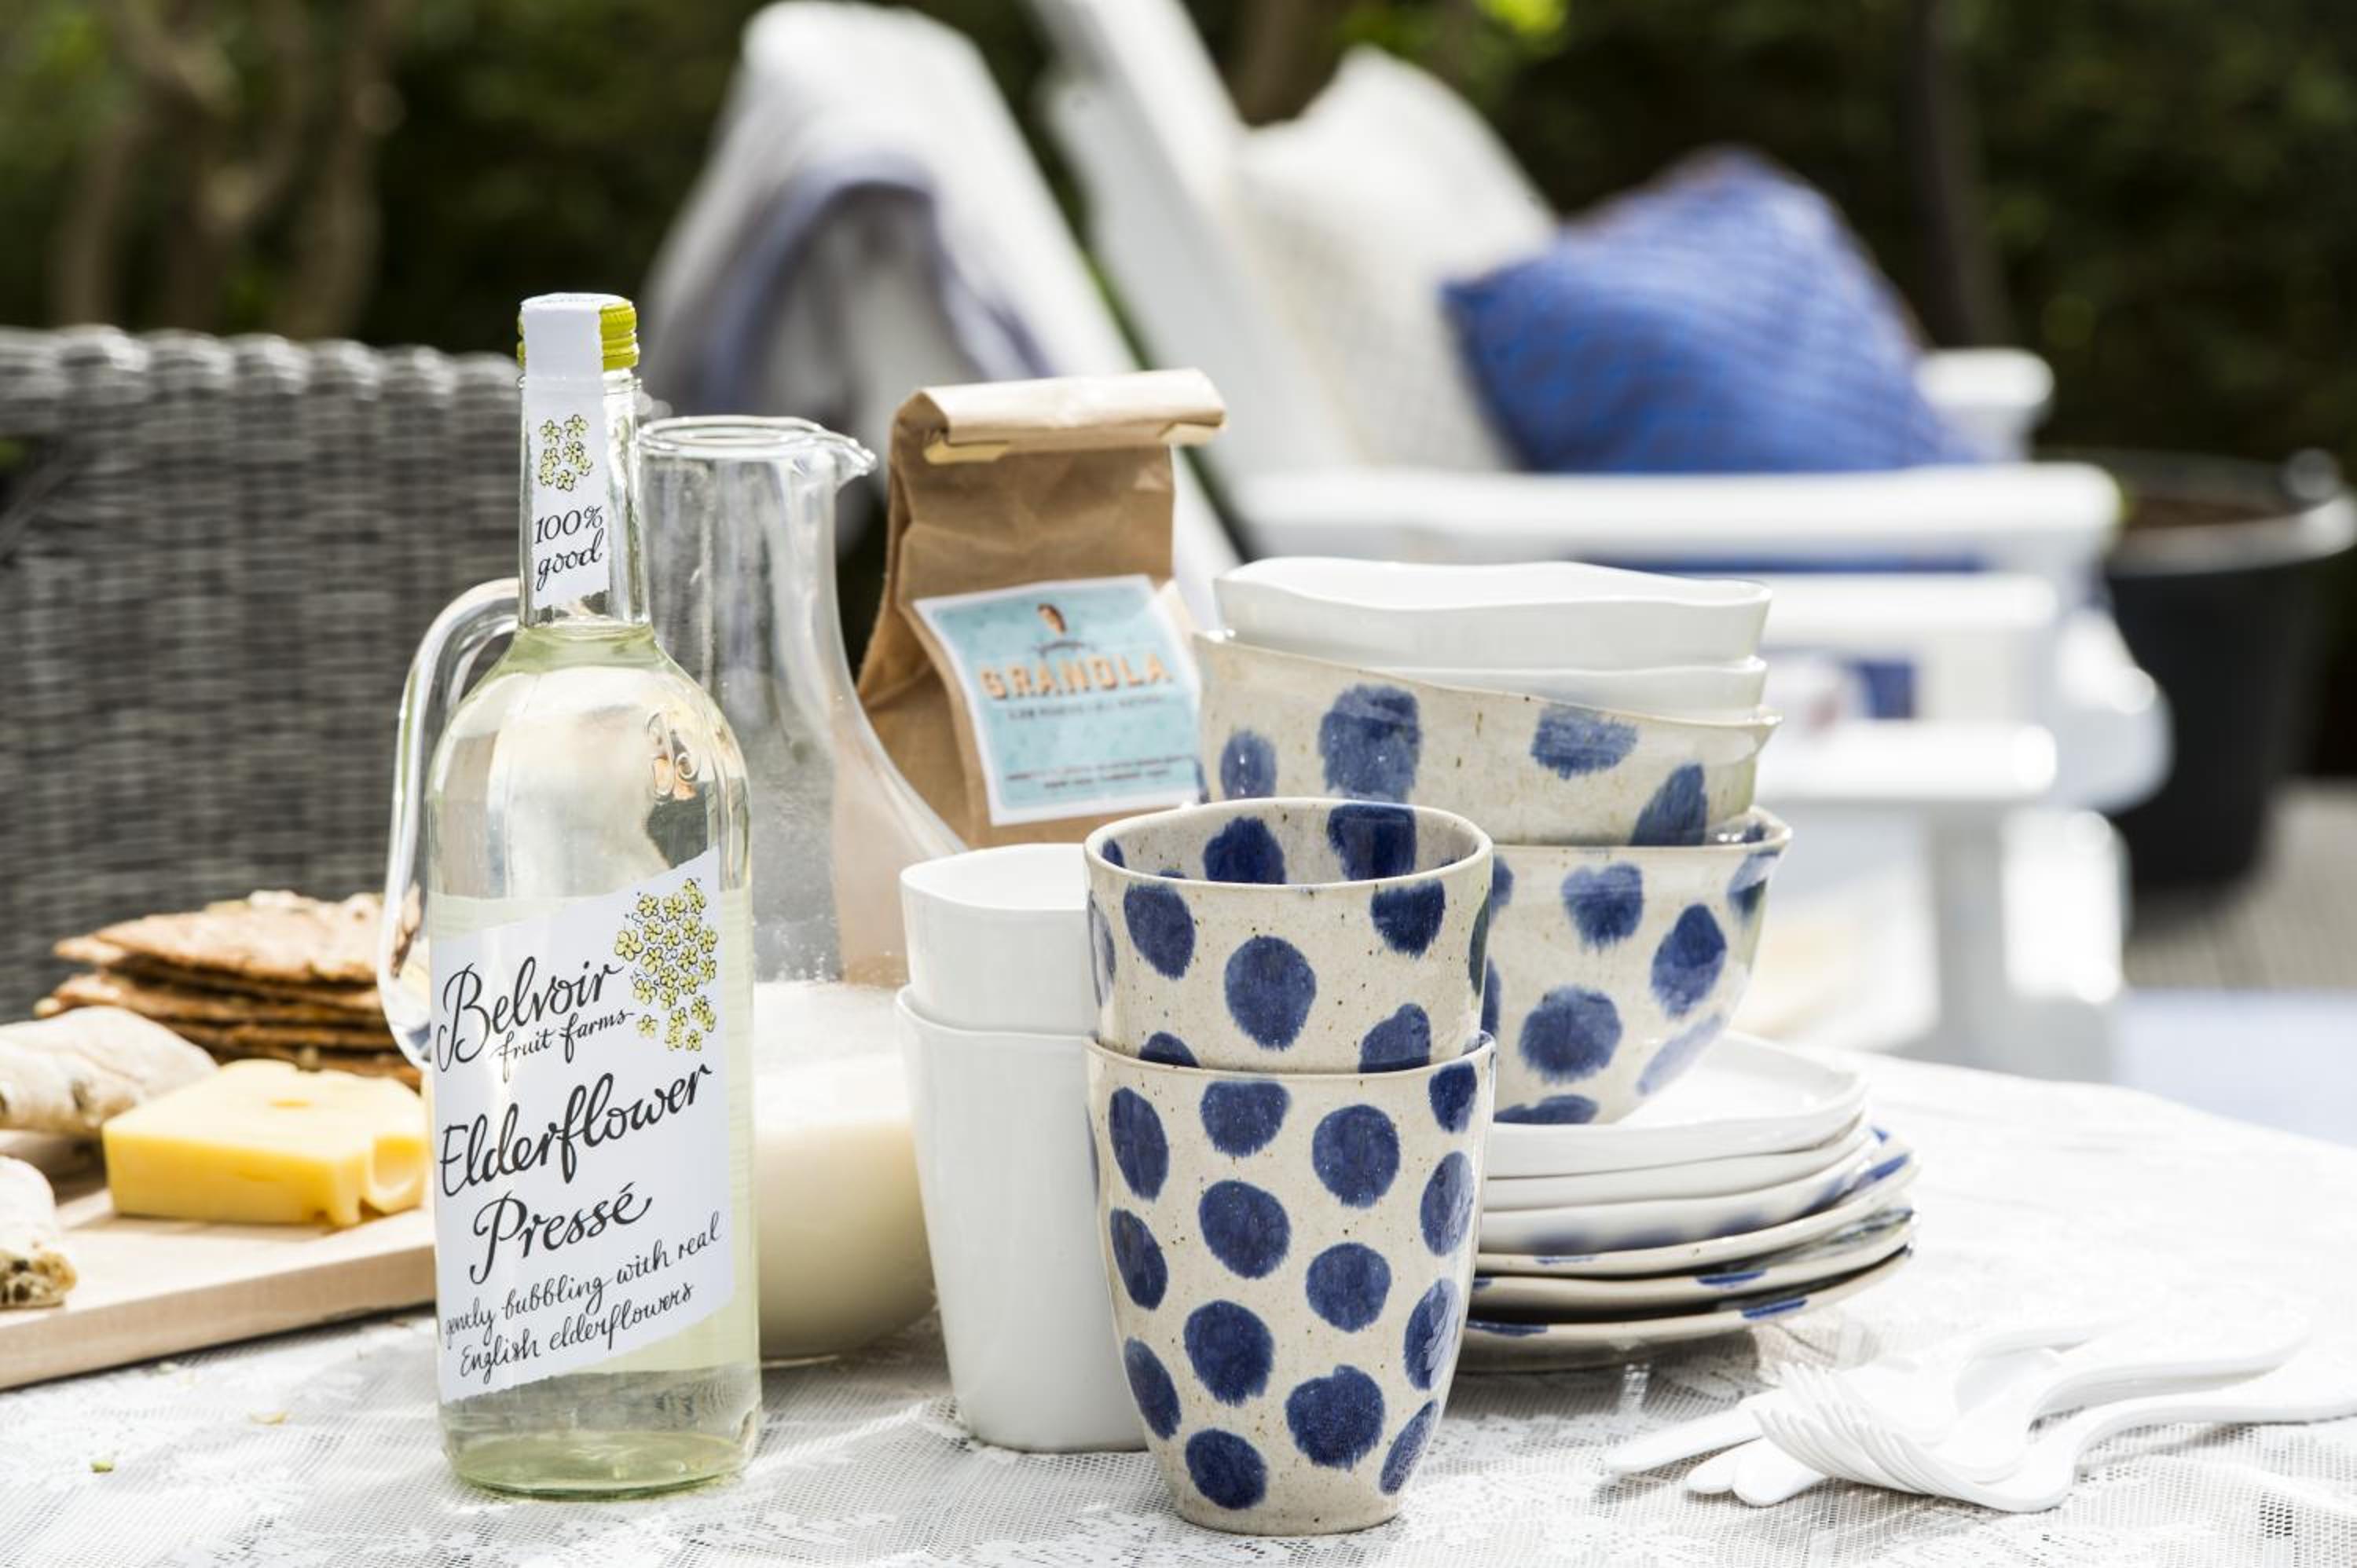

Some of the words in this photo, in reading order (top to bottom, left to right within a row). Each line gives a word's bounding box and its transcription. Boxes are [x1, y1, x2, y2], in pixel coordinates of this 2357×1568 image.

[534, 505, 603, 544] 100%
[536, 529, 604, 591] good
[981, 652, 1174, 701] GRANOLA
[437, 956, 624, 1072] Belvoir
[492, 1030, 555, 1083] fruit
[559, 1011, 636, 1063] farms
[440, 1064, 713, 1196] Elderflower
[445, 1297, 496, 1350] gently
[500, 1274, 614, 1315] bubbling
[616, 1240, 675, 1283] with
[677, 1210, 722, 1261] real
[469, 1181, 653, 1284] Pressé
[460, 1328, 541, 1384] English
[549, 1283, 695, 1350] elderflowers
